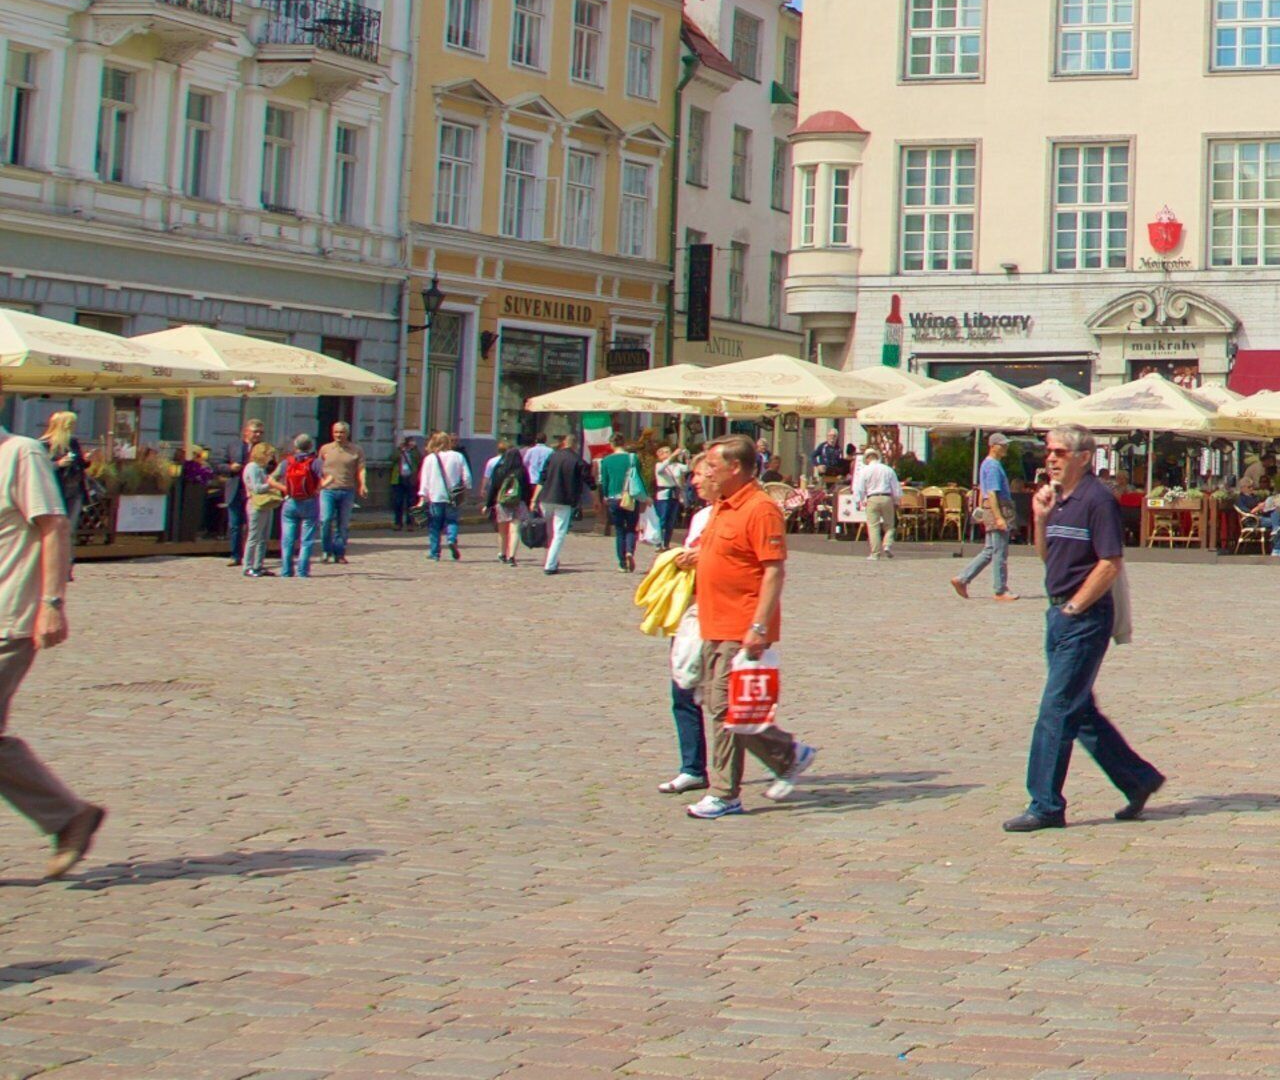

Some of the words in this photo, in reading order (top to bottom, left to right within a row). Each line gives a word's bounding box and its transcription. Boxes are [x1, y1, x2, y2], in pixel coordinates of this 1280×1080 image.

[504, 295, 592, 323] SUVENIIRID
[908, 312, 958, 328] Wine
[963, 312, 1032, 331] Library
[705, 336, 744, 358] ANTIIK
[1131, 338, 1198, 351] maikrahv
